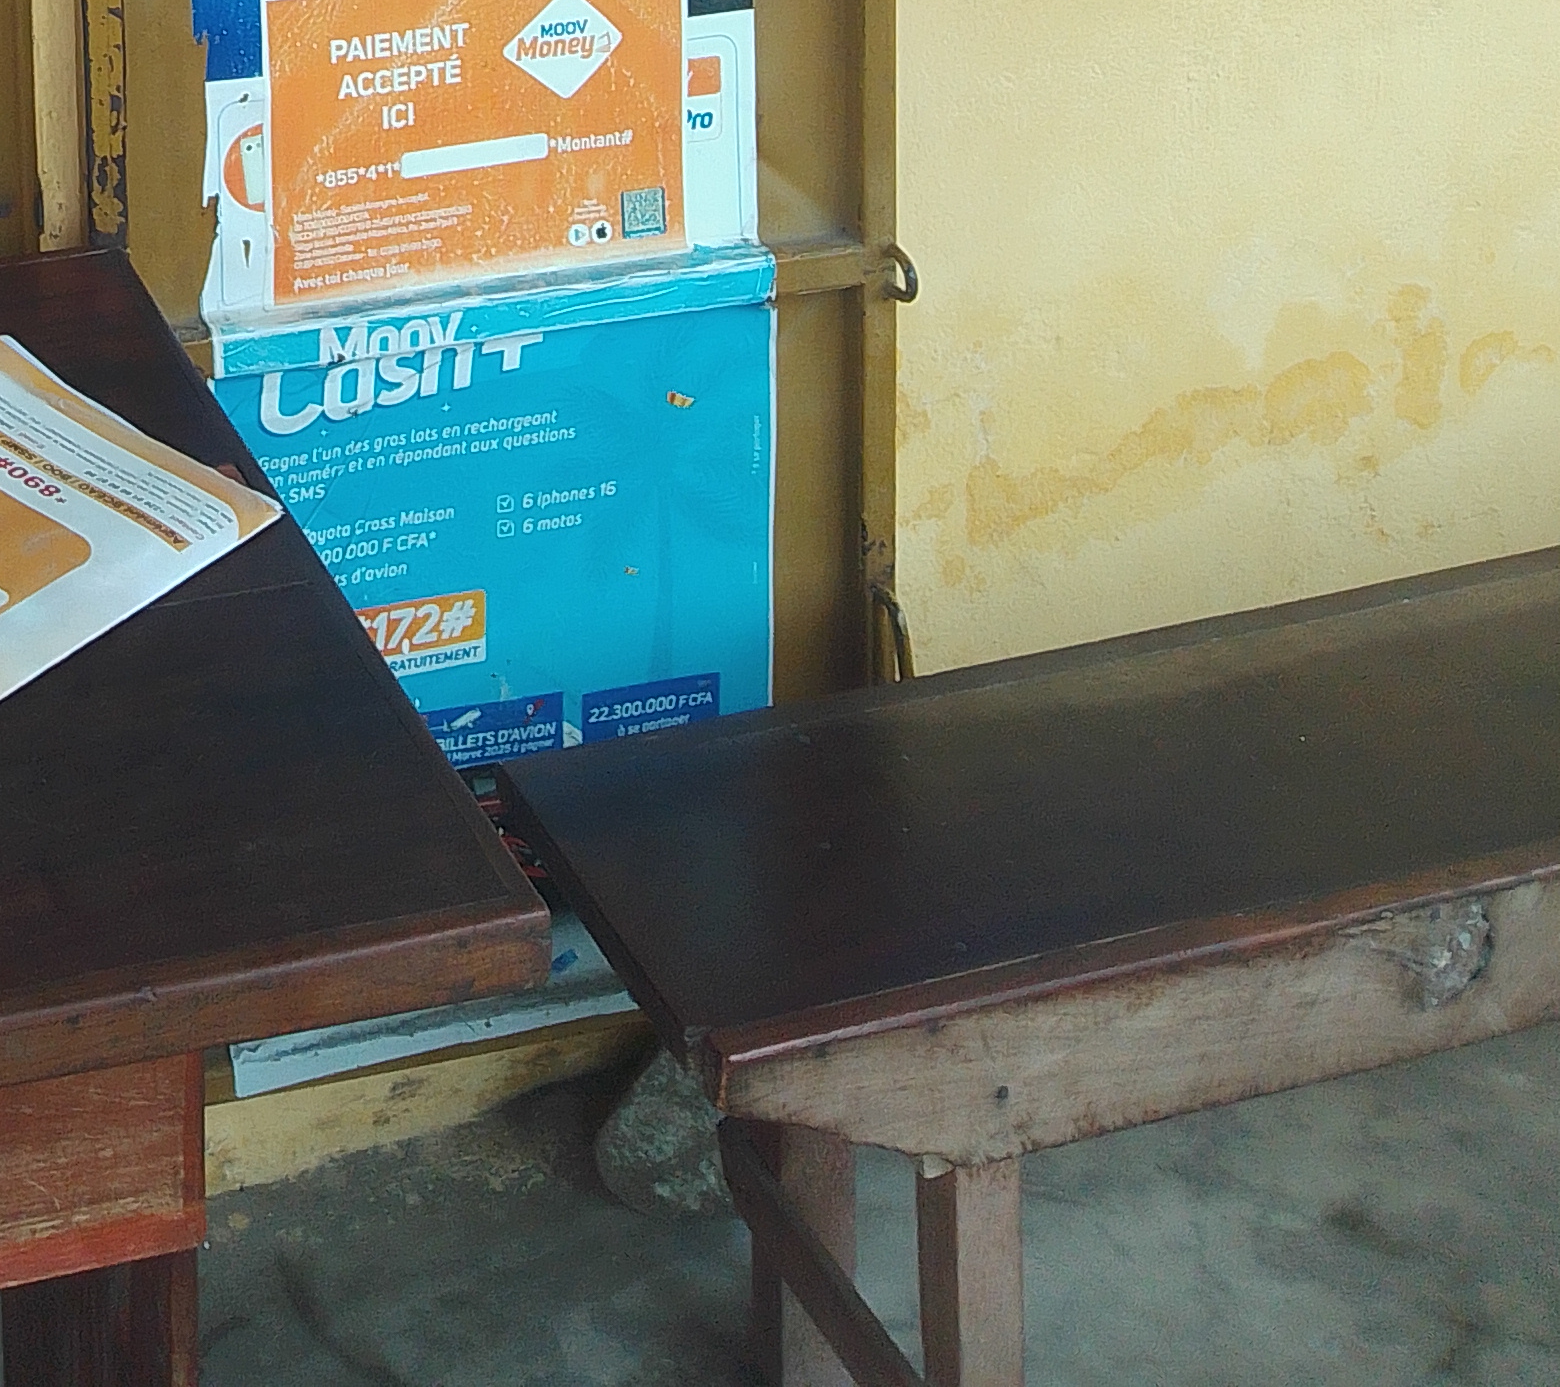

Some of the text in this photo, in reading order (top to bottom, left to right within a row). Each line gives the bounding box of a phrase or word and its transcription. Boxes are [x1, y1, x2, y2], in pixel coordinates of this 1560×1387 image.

[539, 20, 588, 37] MOOV
[329, 24, 469, 64] PAIEMENT
[514, 33, 597, 62] Money
[339, 54, 462, 99] ACCEPTÉ
[381, 102, 415, 129] ICI
[294, 277, 323, 289] Avec
[342, 268, 384, 283] chaque
[318, 311, 464, 367] Moov
[344, 440, 370, 457] des
[374, 434, 406, 453] gros
[410, 428, 439, 443] lots
[442, 425, 461, 438] en
[464, 410, 558, 435] rechargeant
[348, 427, 577, 473] et en répondant aux questions
[288, 484, 327, 503] SMS
[522, 494, 534, 509] 6
[599, 481, 617, 499] 16
[354, 506, 455, 536] Cross Maison
[522, 512, 583, 534] 6 motos
[382, 535, 393, 553] F
[351, 564, 408, 584] d'avion
[389, 644, 481, 672] RATUITEMENT
[588, 695, 676, 723] 22.300.000
[499, 721, 557, 745] D'AVION
